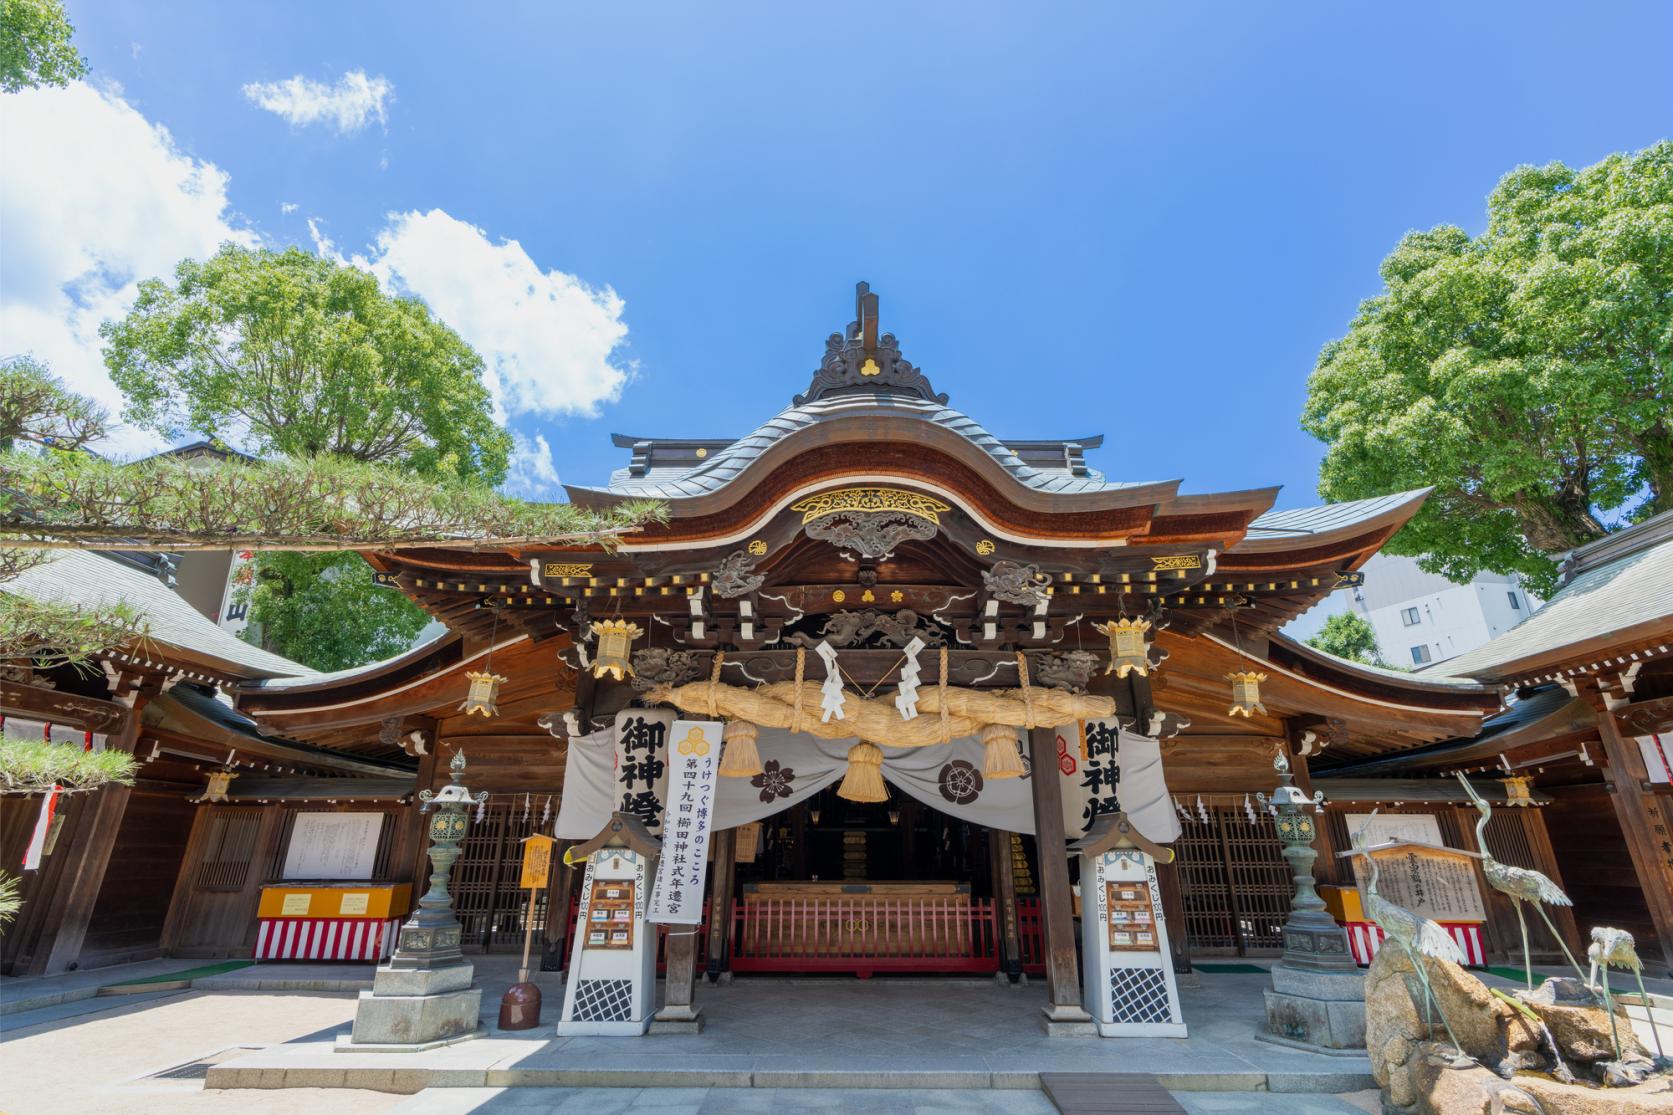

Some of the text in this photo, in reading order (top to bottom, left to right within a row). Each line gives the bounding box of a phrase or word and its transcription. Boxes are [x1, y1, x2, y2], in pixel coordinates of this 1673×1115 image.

[619, 716, 666, 827] 御神燈
[690, 757, 712, 885] うけつぐ博多のこころ
